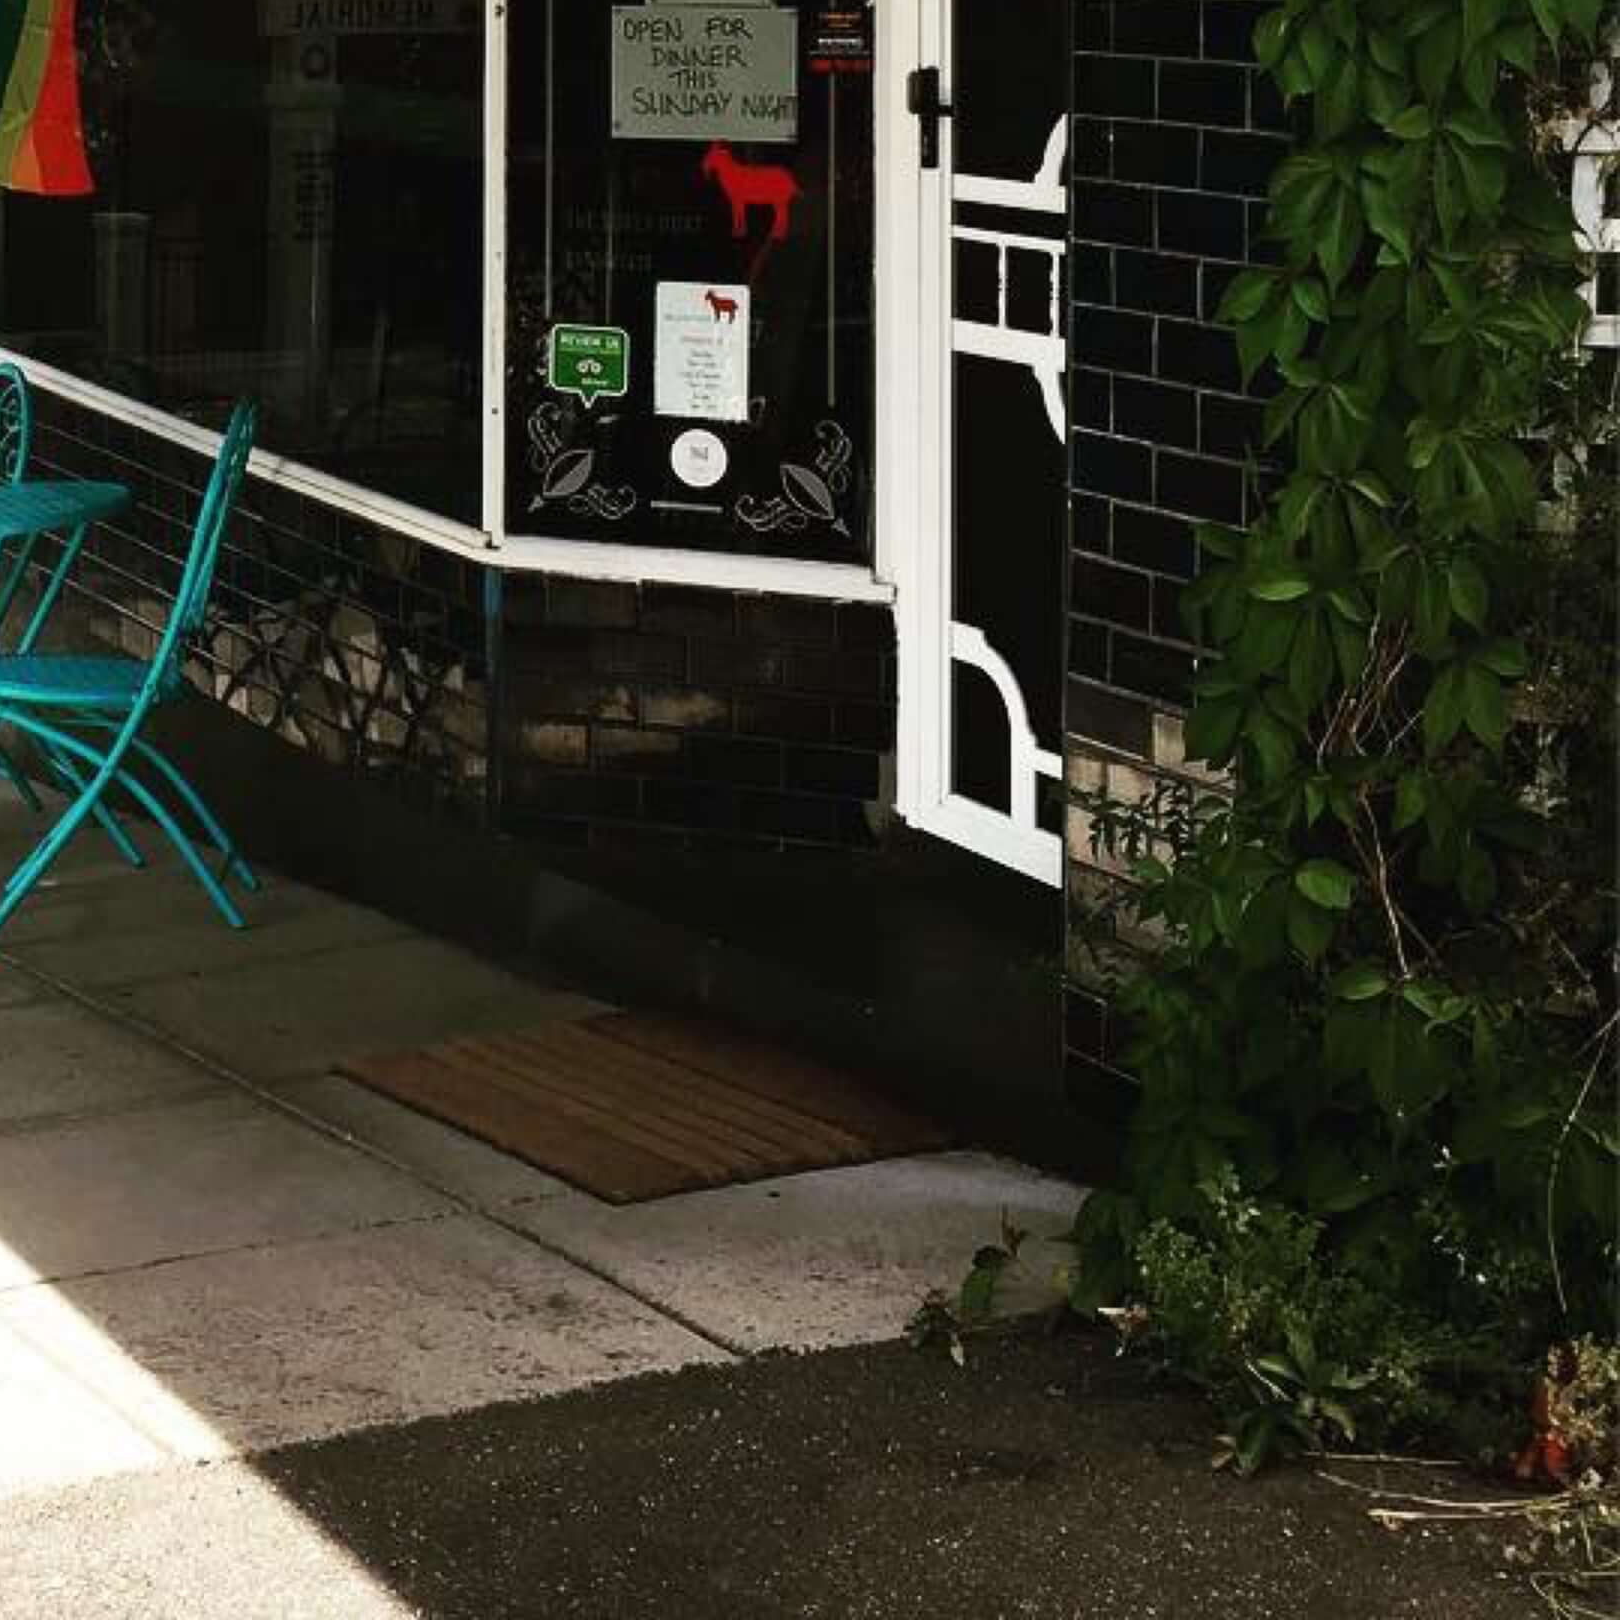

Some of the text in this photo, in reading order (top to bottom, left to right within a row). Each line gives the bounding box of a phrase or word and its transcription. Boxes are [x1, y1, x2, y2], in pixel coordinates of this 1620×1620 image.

[622, 16, 753, 42] OPEN FOR
[648, 44, 750, 70] DINNER
[668, 68, 718, 90] THIS
[631, 86, 733, 117] SUNDAY
